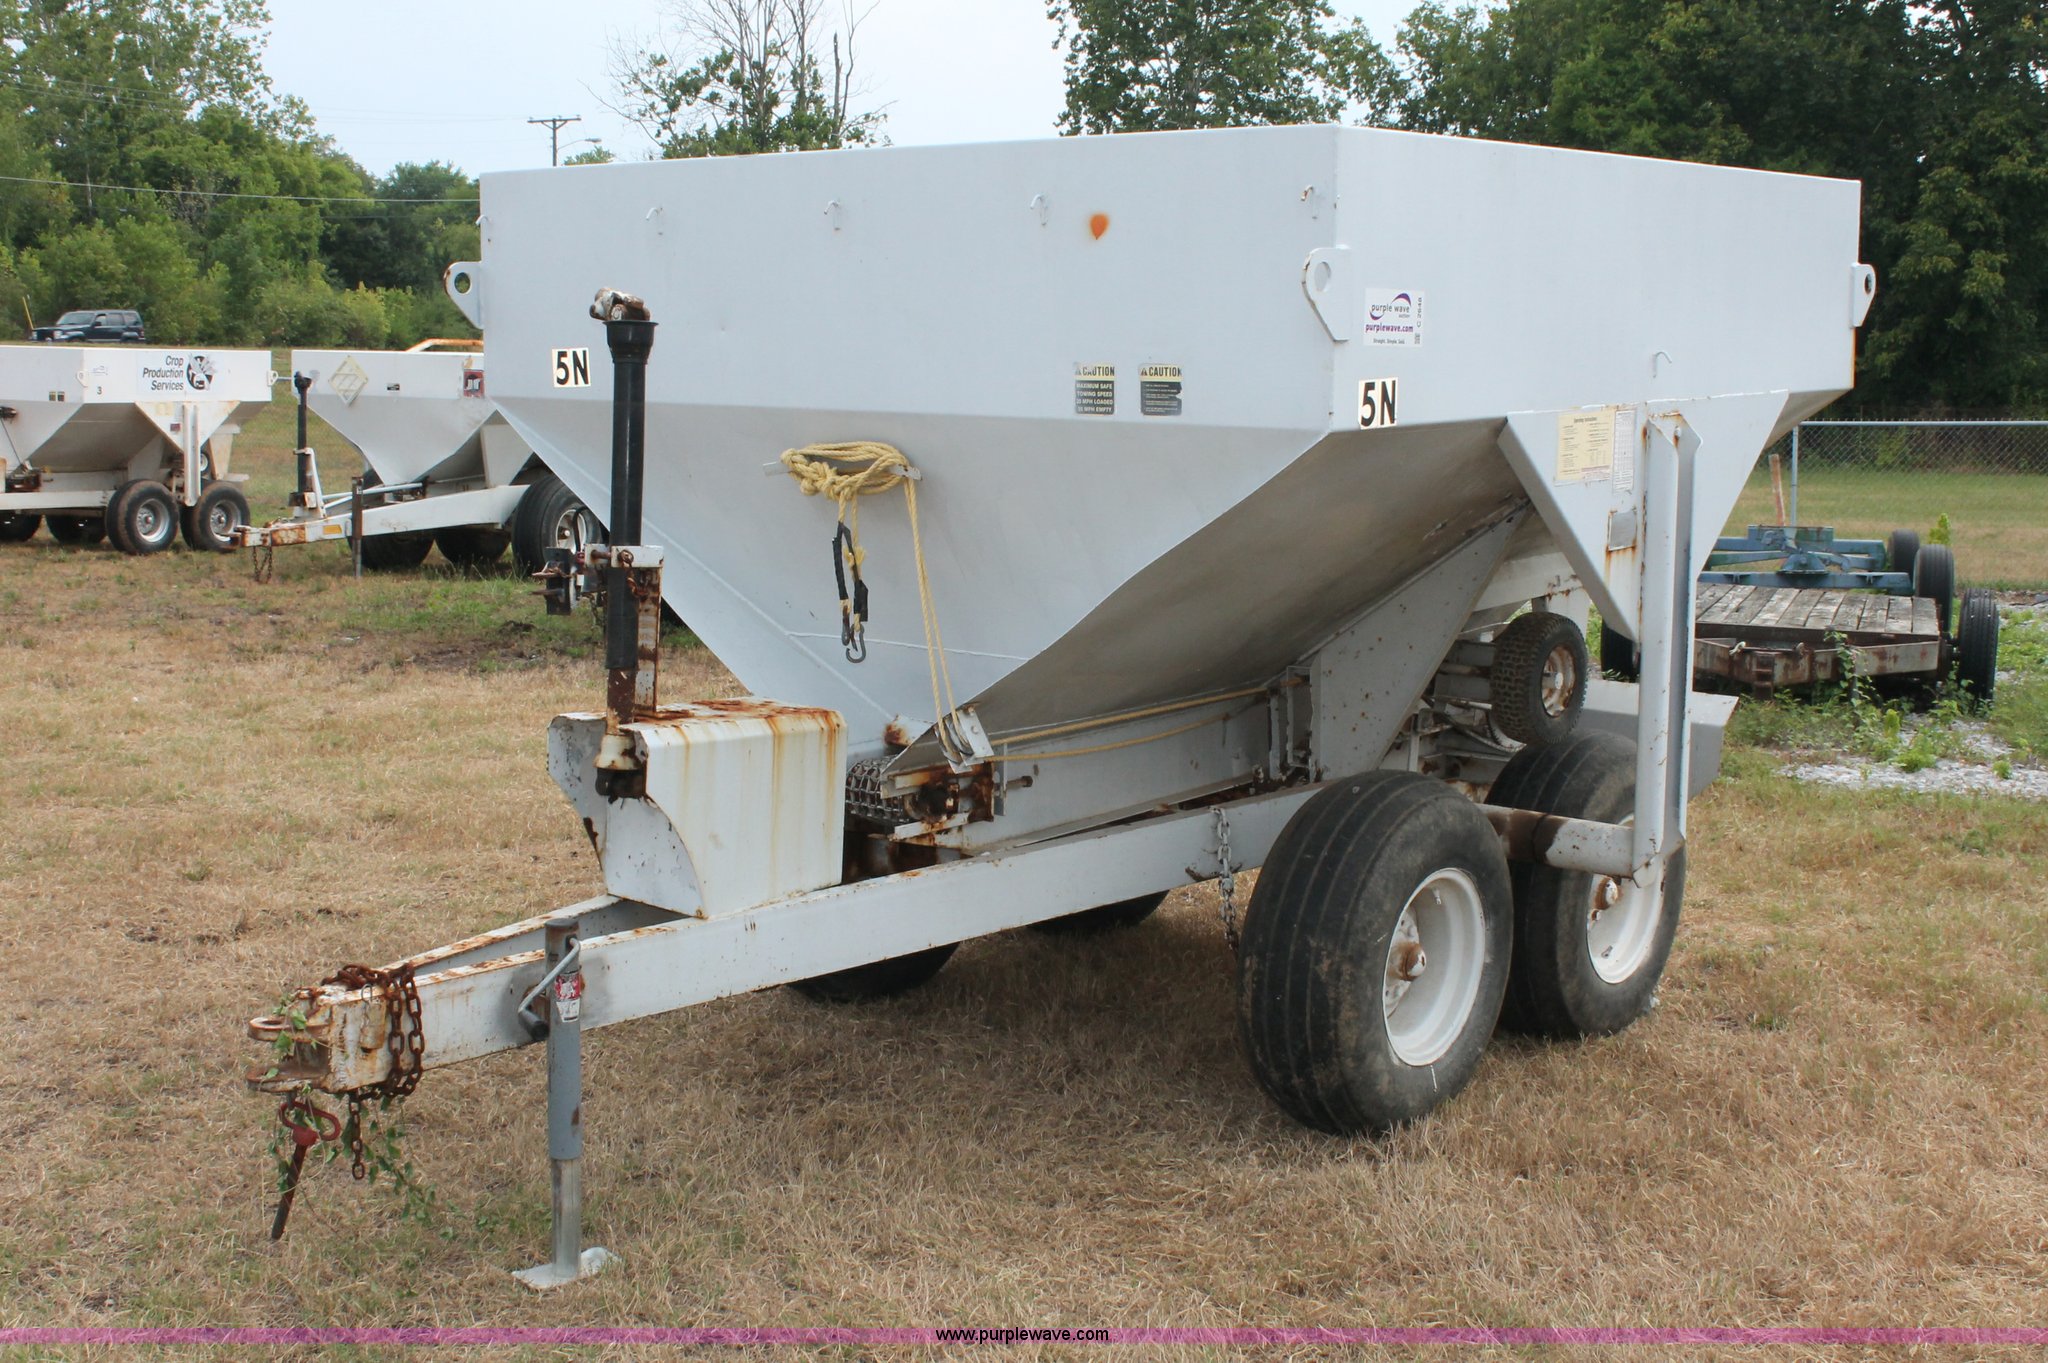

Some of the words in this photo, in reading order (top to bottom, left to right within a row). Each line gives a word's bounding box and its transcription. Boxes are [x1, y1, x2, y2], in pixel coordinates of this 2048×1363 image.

[1371, 304, 1393, 313] purple
[1365, 323, 1414, 333] purplewave.com
[165, 355, 184, 367] Crop
[142, 367, 184, 379] Production
[555, 350, 589, 385] 5N
[1082, 366, 1115, 377] CAUTION
[96, 386, 103, 395] 3
[151, 380, 184, 391] Services
[1360, 380, 1397, 428] 5N
